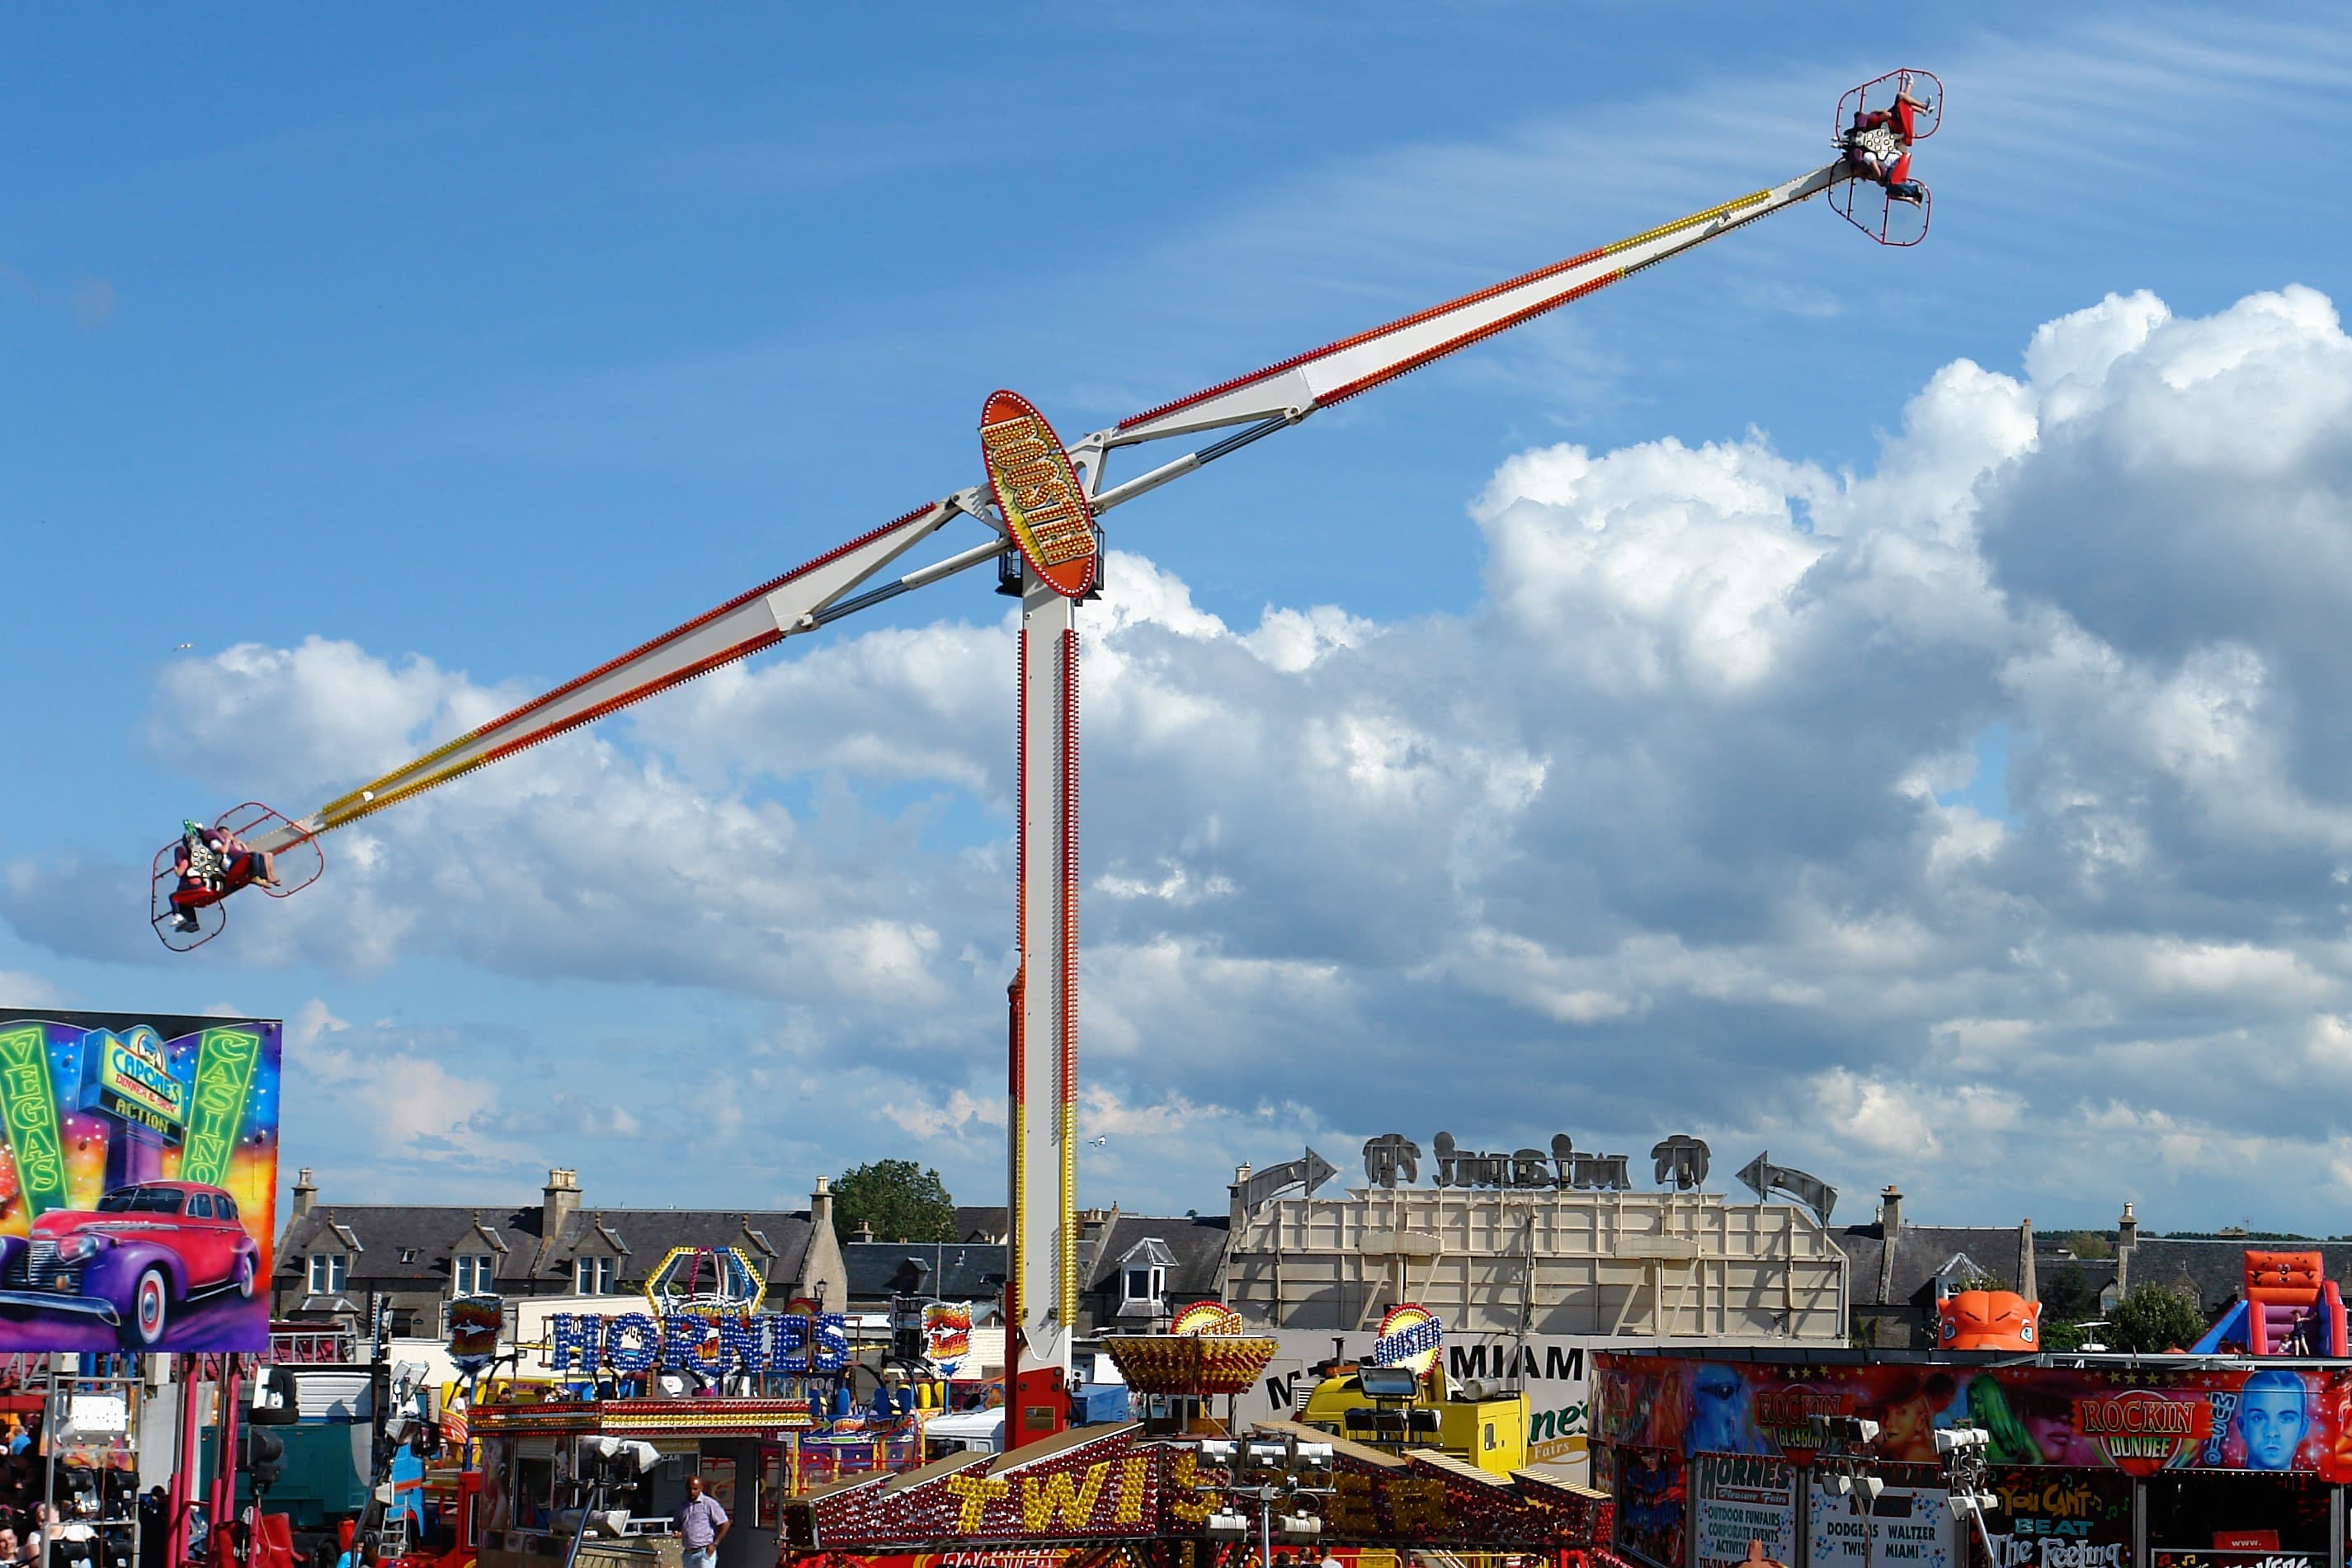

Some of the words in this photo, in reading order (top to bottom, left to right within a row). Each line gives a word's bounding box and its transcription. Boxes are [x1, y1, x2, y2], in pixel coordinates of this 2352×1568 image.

[979, 415, 1096, 566] BOOSTER
[115, 1073, 147, 1099] DINNER
[0, 1034, 58, 1191] VEGAS
[115, 1097, 168, 1134] ACTION
[186, 1034, 248, 1186] CASINO
[552, 1312, 850, 1373] HORNES
[1373, 1316, 1442, 1367] BOOSTER
[1758, 1392, 1842, 1425] ROCKIN
[2082, 1401, 2195, 1433] ROCKIN
[2204, 1391, 2238, 1465] MUSIC
[1533, 1440, 1570, 1460] Fairs
[2109, 1436, 2171, 1457] DUNDEE
[1700, 1456, 1790, 1500] HORNES
[1708, 1505, 1743, 1523] OUTDOOR
[1745, 1510, 1780, 1528] FUNFAIRS
[1888, 1524, 1935, 1541] WALTZER
[2015, 1518, 2094, 1536] BEAT
[1709, 1523, 1751, 1541] CORPORATE
[1752, 1528, 1779, 1543] EVENTS
[1716, 1540, 1747, 1556] ACTIVITY
[1842, 1542, 1872, 1556] TWIS
[1885, 1543, 1919, 1559] MIAMI
[1988, 1533, 2034, 1568] The
